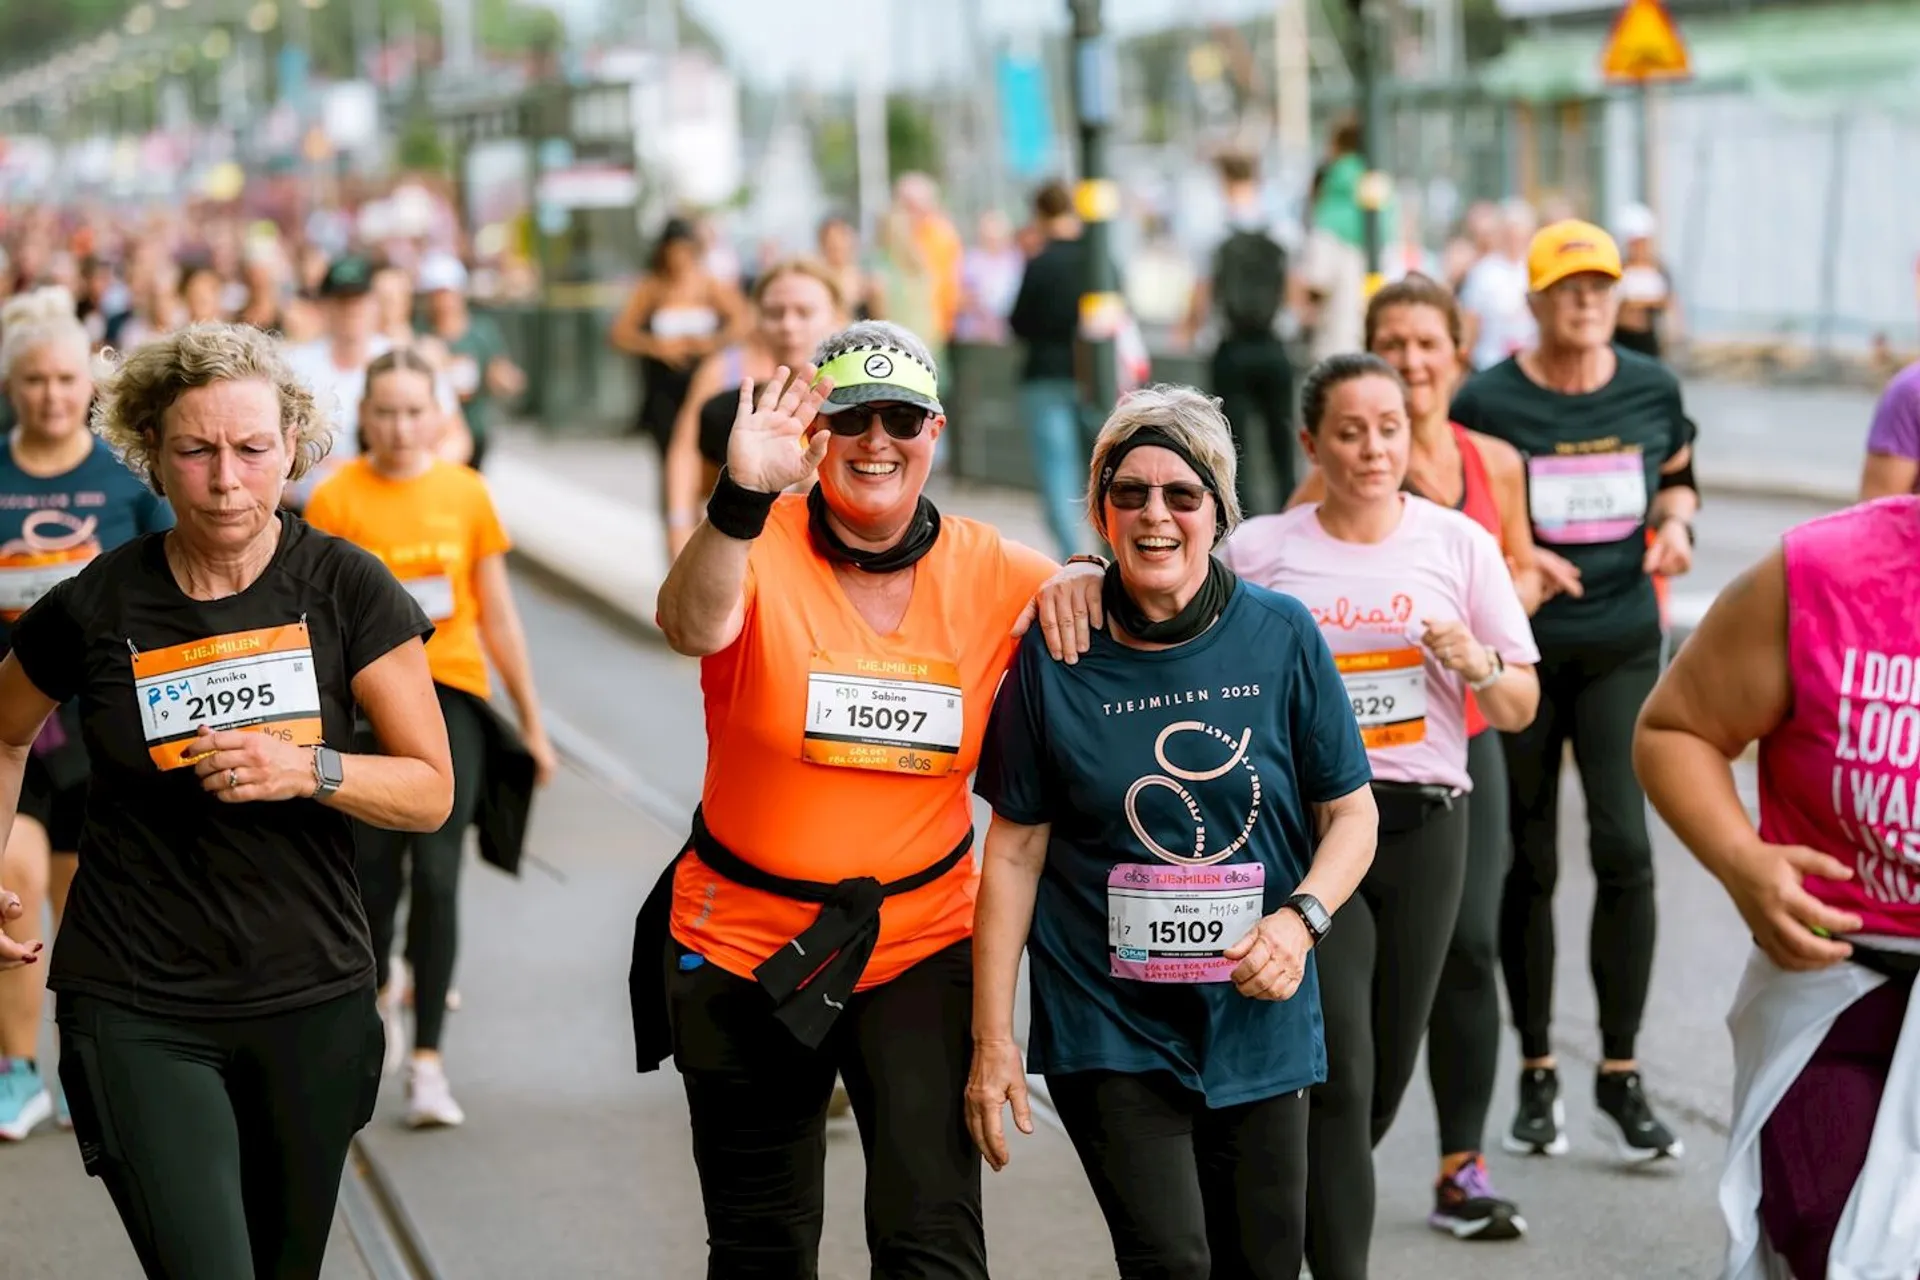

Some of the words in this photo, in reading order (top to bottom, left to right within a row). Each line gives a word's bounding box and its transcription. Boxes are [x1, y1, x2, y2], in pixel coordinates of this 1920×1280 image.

[181, 637, 261, 662] TJEJMILEN
[855, 659, 929, 676] TJEJMILEN
[206, 672, 248, 687] Annika
[186, 683, 275, 722] 21995
[871, 690, 907, 703] Sabine
[1103, 689, 1209, 716] TJEJMILEN
[1221, 684, 1261, 699] 2025
[161, 710, 169, 721] 9
[824, 708, 832, 718] 7
[847, 705, 928, 734] 15097
[898, 752, 932, 771] ellos
[1124, 870, 1150, 884] ellos
[1224, 870, 1251, 883] ellos
[1174, 904, 1200, 914] Alice
[1124, 925, 1131, 935] 7
[1149, 920, 1224, 944] 15109
